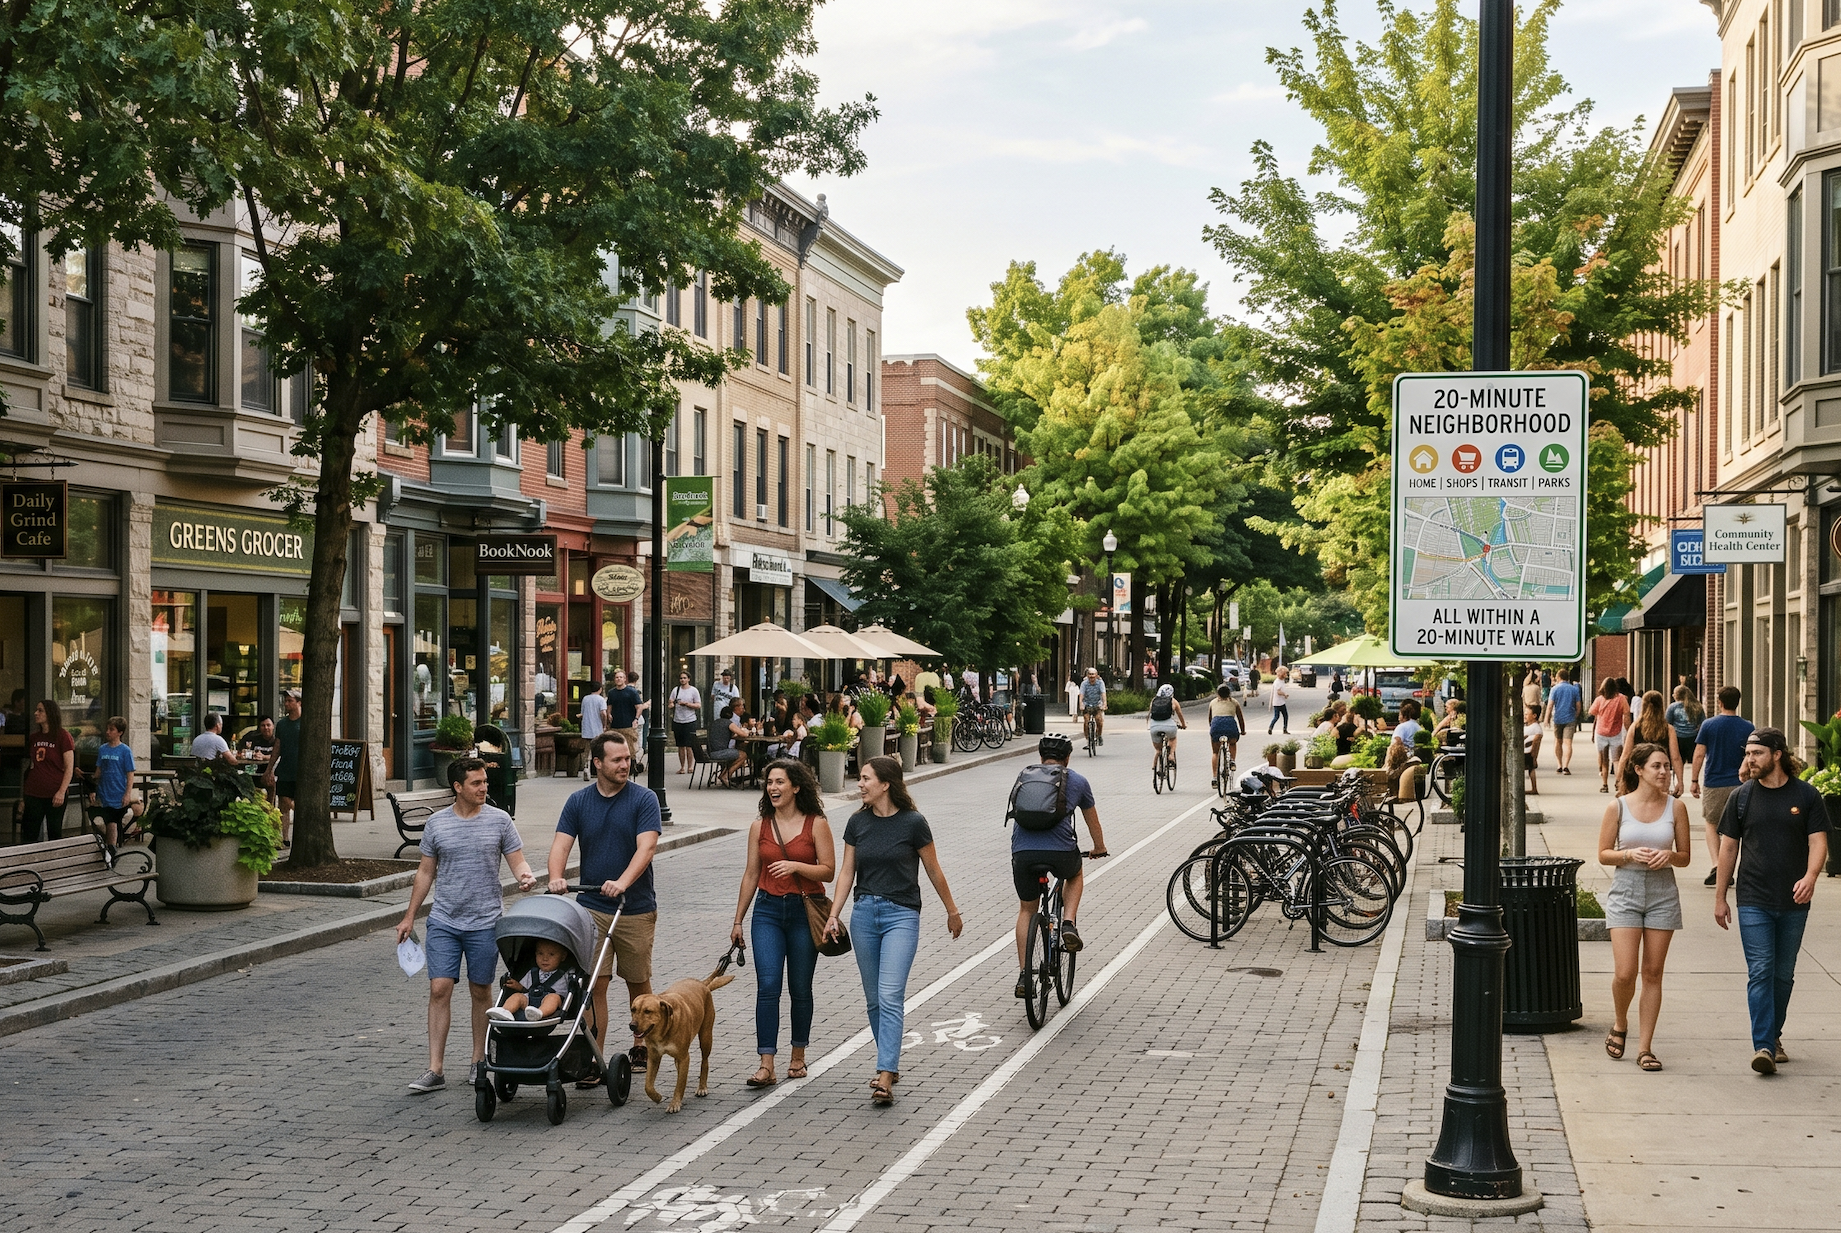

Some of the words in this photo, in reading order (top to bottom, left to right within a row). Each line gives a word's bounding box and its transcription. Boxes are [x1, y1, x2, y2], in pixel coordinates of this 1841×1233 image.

[1433, 387, 1546, 409] 20-MINUTE
[1409, 413, 1571, 435] NEIGHBORHOOD
[1409, 478, 1437, 488] HOME
[1446, 477, 1478, 488] SHOPS
[1488, 477, 1528, 488] TRANSIT
[1538, 477, 1571, 488] PARKS
[13, 493, 55, 512] Daily
[10, 512, 56, 527] Grind
[16, 531, 52, 546] Cafe
[169, 521, 237, 554] GREENS
[241, 529, 304, 560] GROCER
[1714, 529, 1775, 541] Community
[478, 543, 553, 558] BookNook
[1709, 541, 1743, 551] Health
[1745, 541, 1781, 551] Center
[1432, 608, 1462, 624] ALL
[1466, 608, 1524, 625] WITHIN
[1529, 609, 1541, 625] A
[1417, 628, 1506, 646] 20-MINUTE
[1511, 629, 1556, 647] WALK
